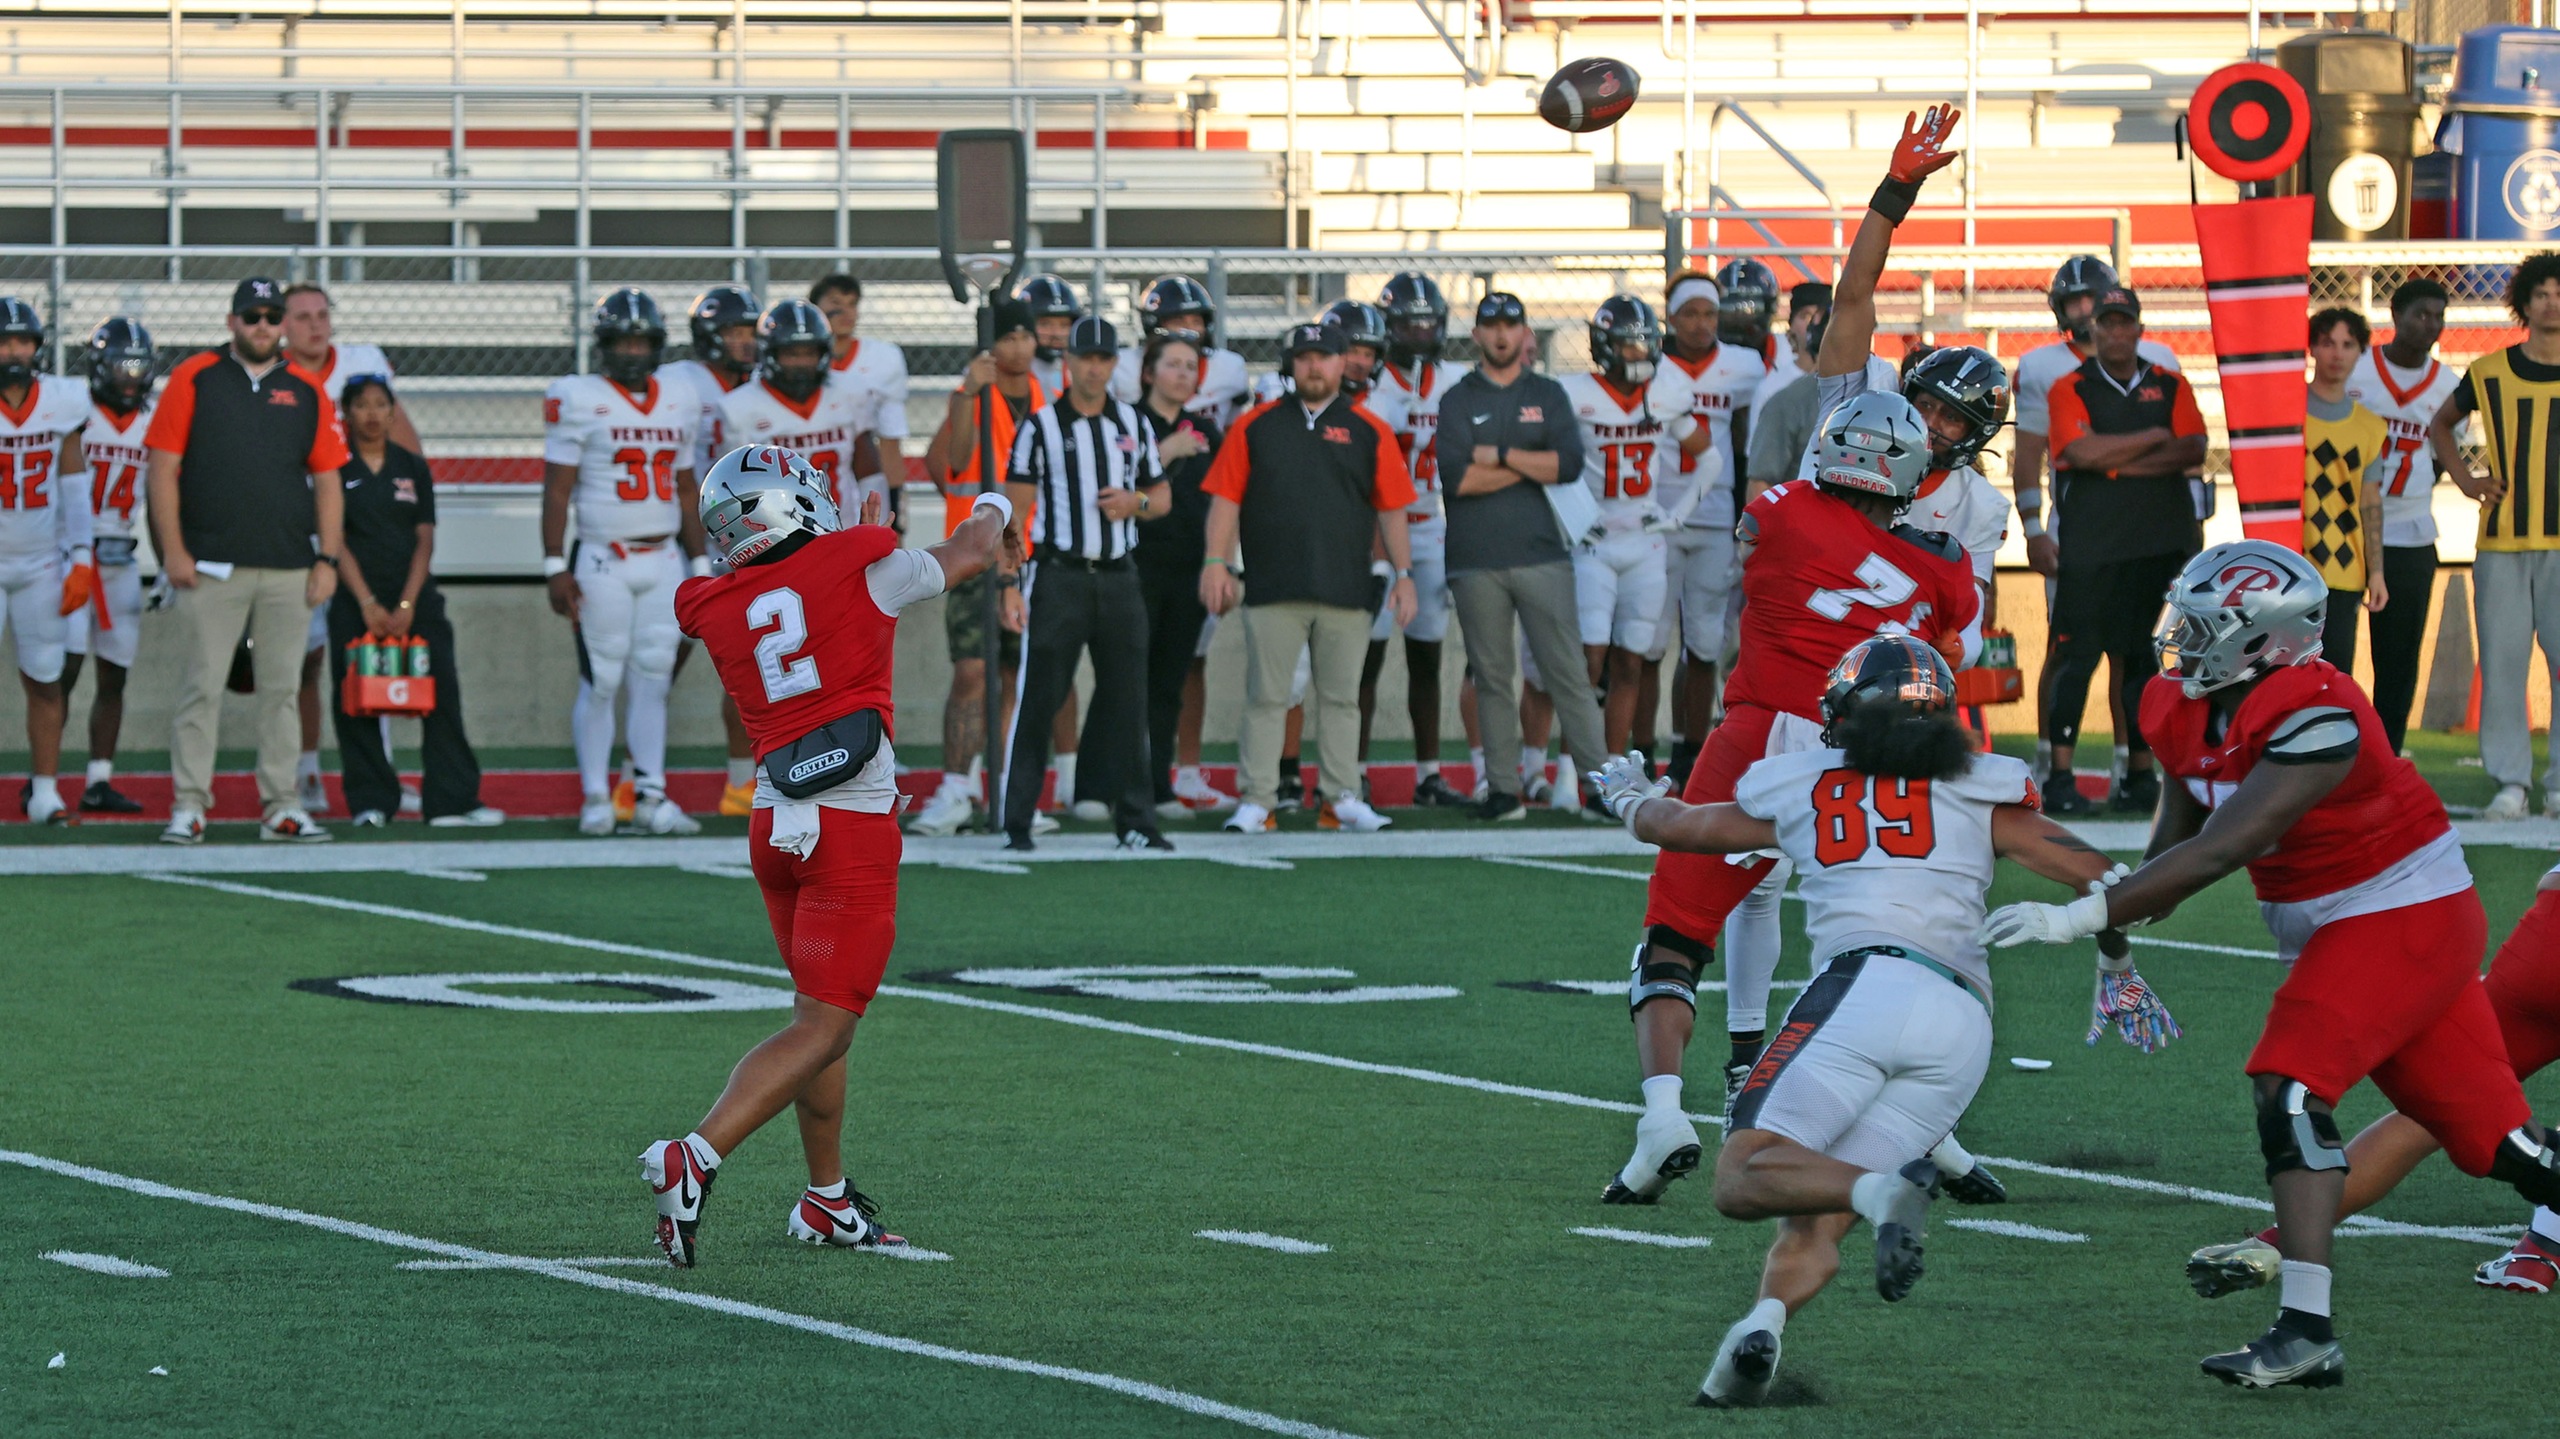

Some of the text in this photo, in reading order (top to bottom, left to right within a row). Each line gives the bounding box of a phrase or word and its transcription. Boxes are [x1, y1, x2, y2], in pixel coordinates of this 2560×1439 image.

[1936, 379, 1963, 400] Riddell
[1860, 433, 1872, 446] 71
[1599, 442, 1655, 498] 13
[1829, 472, 1888, 493] PALOMAR
[90, 460, 136, 520] 14
[718, 513, 727, 525] 2
[728, 538, 773, 569] ALOMAR
[2219, 564, 2281, 608] P
[745, 585, 823, 704] 2
[387, 679, 410, 706] G
[794, 751, 844, 779] BATTLE
[1811, 766, 1937, 869] 89
[2118, 983, 2145, 1010] NFL
[1743, 1022, 1817, 1094] VENTURA
